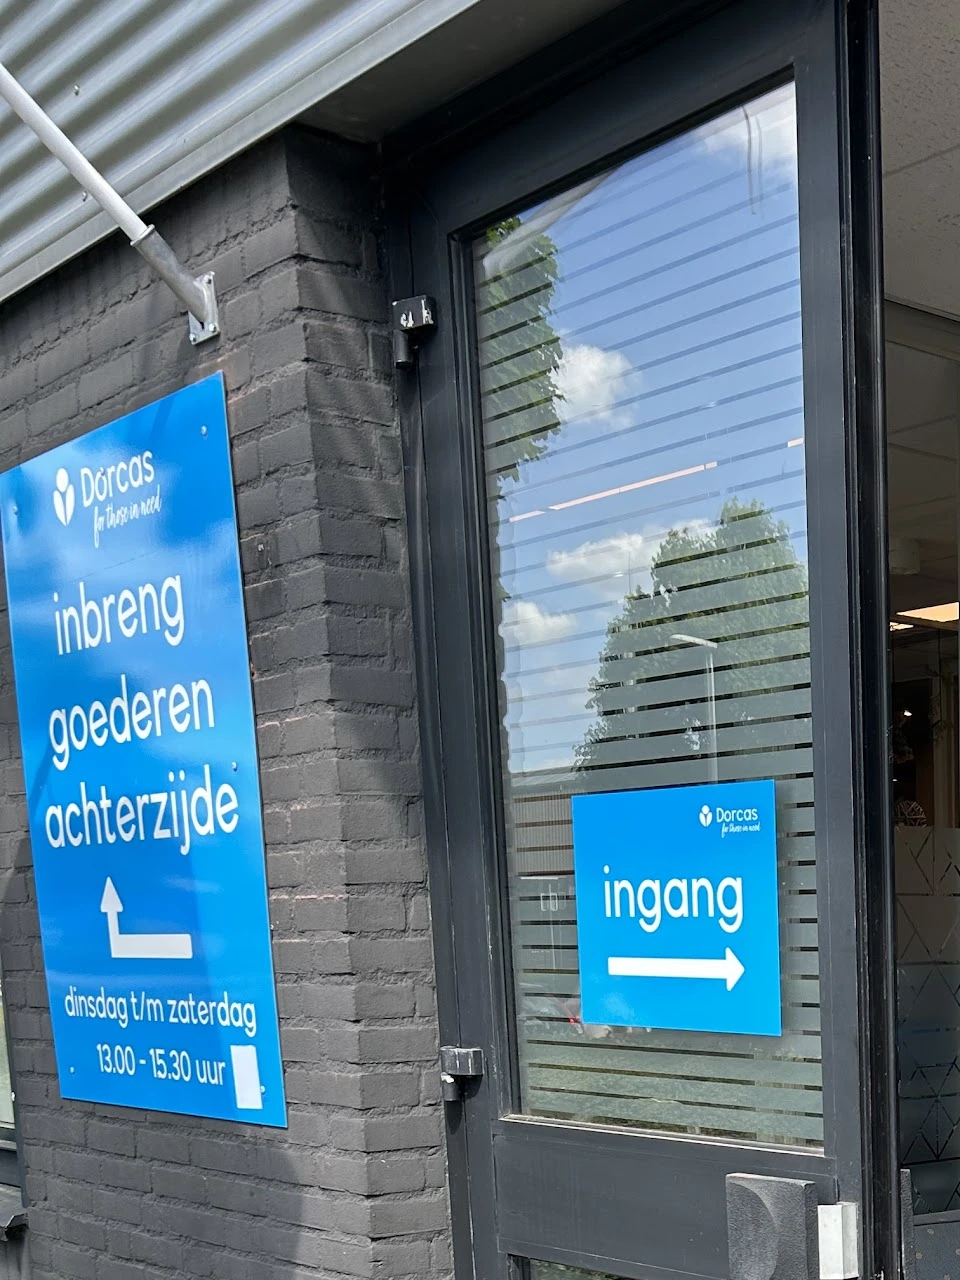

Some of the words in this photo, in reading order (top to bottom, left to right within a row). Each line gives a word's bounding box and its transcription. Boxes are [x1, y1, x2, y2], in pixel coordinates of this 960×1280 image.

[81, 451, 155, 508] Dorcas
[94, 506, 105, 549] for
[106, 502, 129, 529] those
[130, 502, 141, 520] in
[141, 484, 162, 515] need
[54, 574, 185, 656] inbreng
[49, 674, 215, 771] goederen
[45, 764, 239, 856] achterzijde
[716, 807, 758, 823] Dorcas
[604, 864, 744, 933] ingang
[64, 985, 129, 1029] dinsdag
[131, 990, 164, 1022] t/m
[167, 990, 257, 1037] zaterdag
[97, 1043, 136, 1076] 13.00
[149, 1047, 191, 1082] 15.30
[196, 1058, 226, 1086] uur
